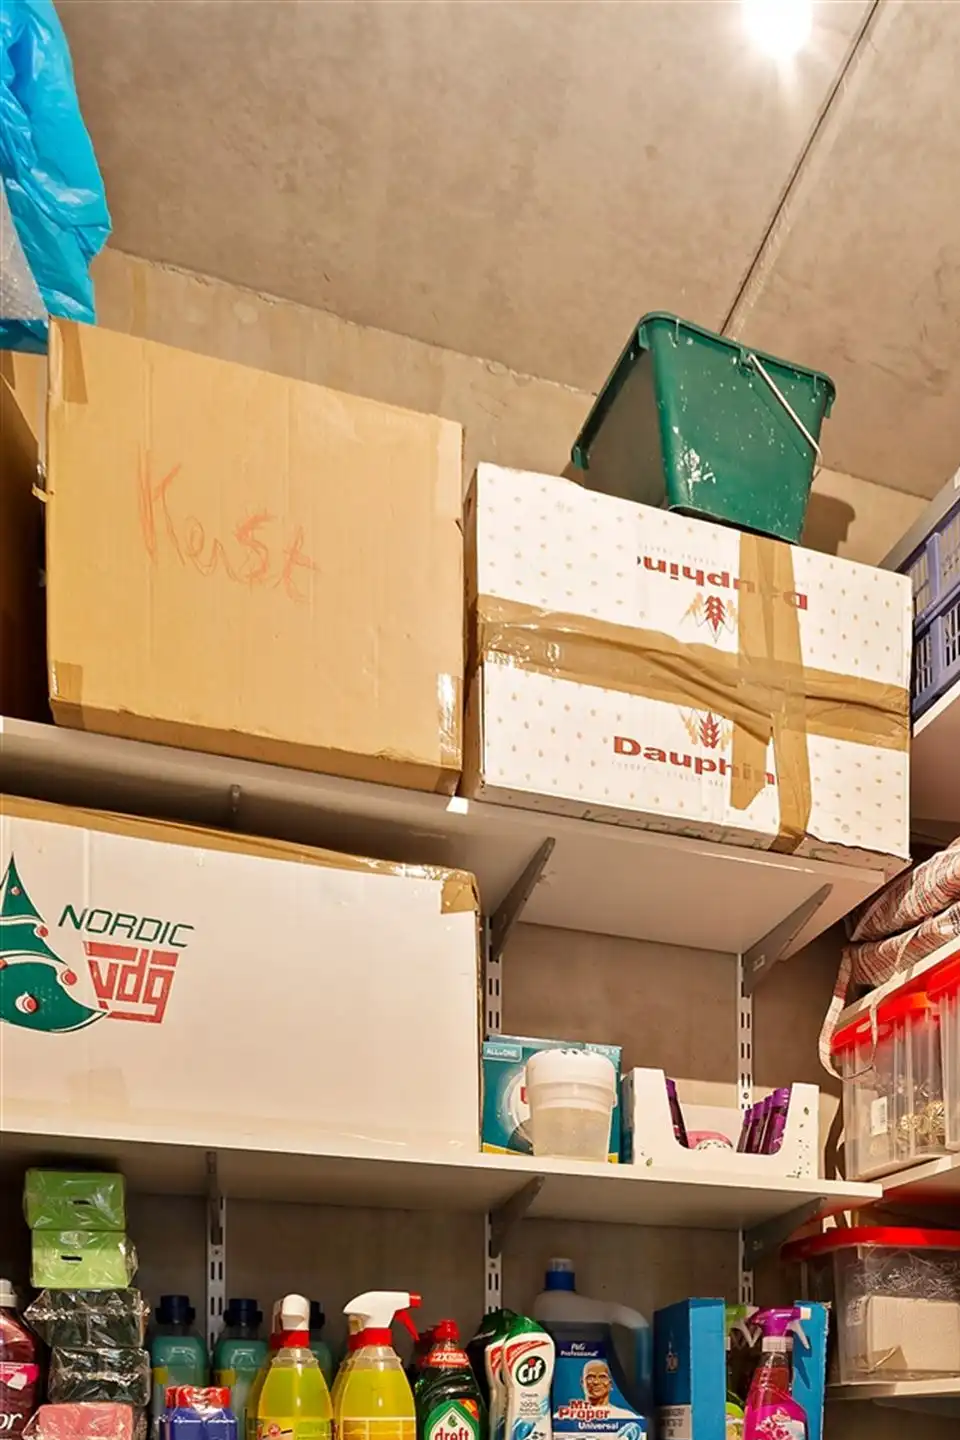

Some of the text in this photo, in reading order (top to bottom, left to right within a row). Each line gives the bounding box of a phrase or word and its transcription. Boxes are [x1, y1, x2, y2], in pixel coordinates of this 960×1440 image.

[57, 904, 195, 949] NORDIC
[517, 1358, 543, 1384] Cif
[570, 1399, 593, 1410] Mr.
[557, 1407, 611, 1422] Proper
[578, 1421, 619, 1431] Universal
